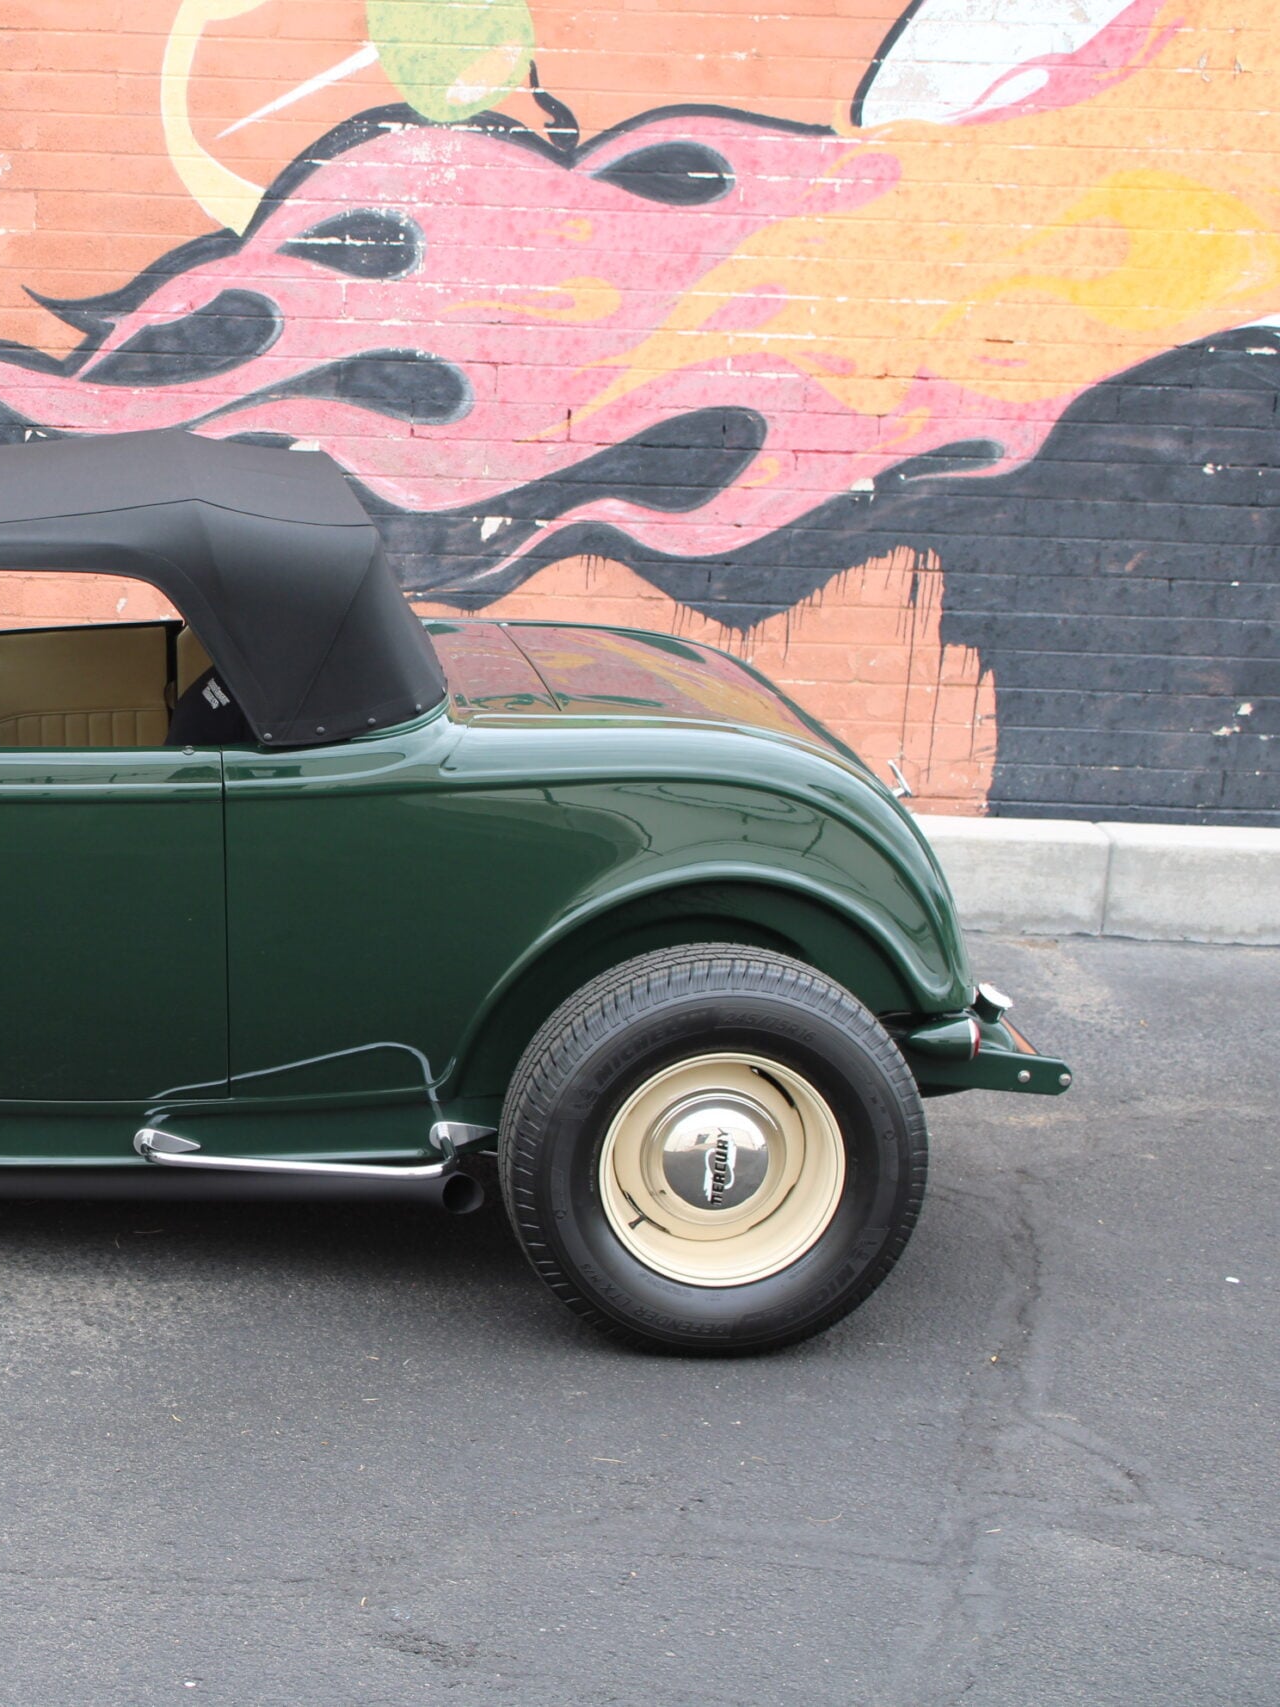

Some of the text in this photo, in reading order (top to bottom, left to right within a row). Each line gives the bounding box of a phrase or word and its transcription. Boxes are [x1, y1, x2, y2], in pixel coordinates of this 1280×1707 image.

[710, 1127, 730, 1206] MERCURY
[599, 1282, 634, 1308] LTX
[633, 1304, 731, 1336] DEFENDER
